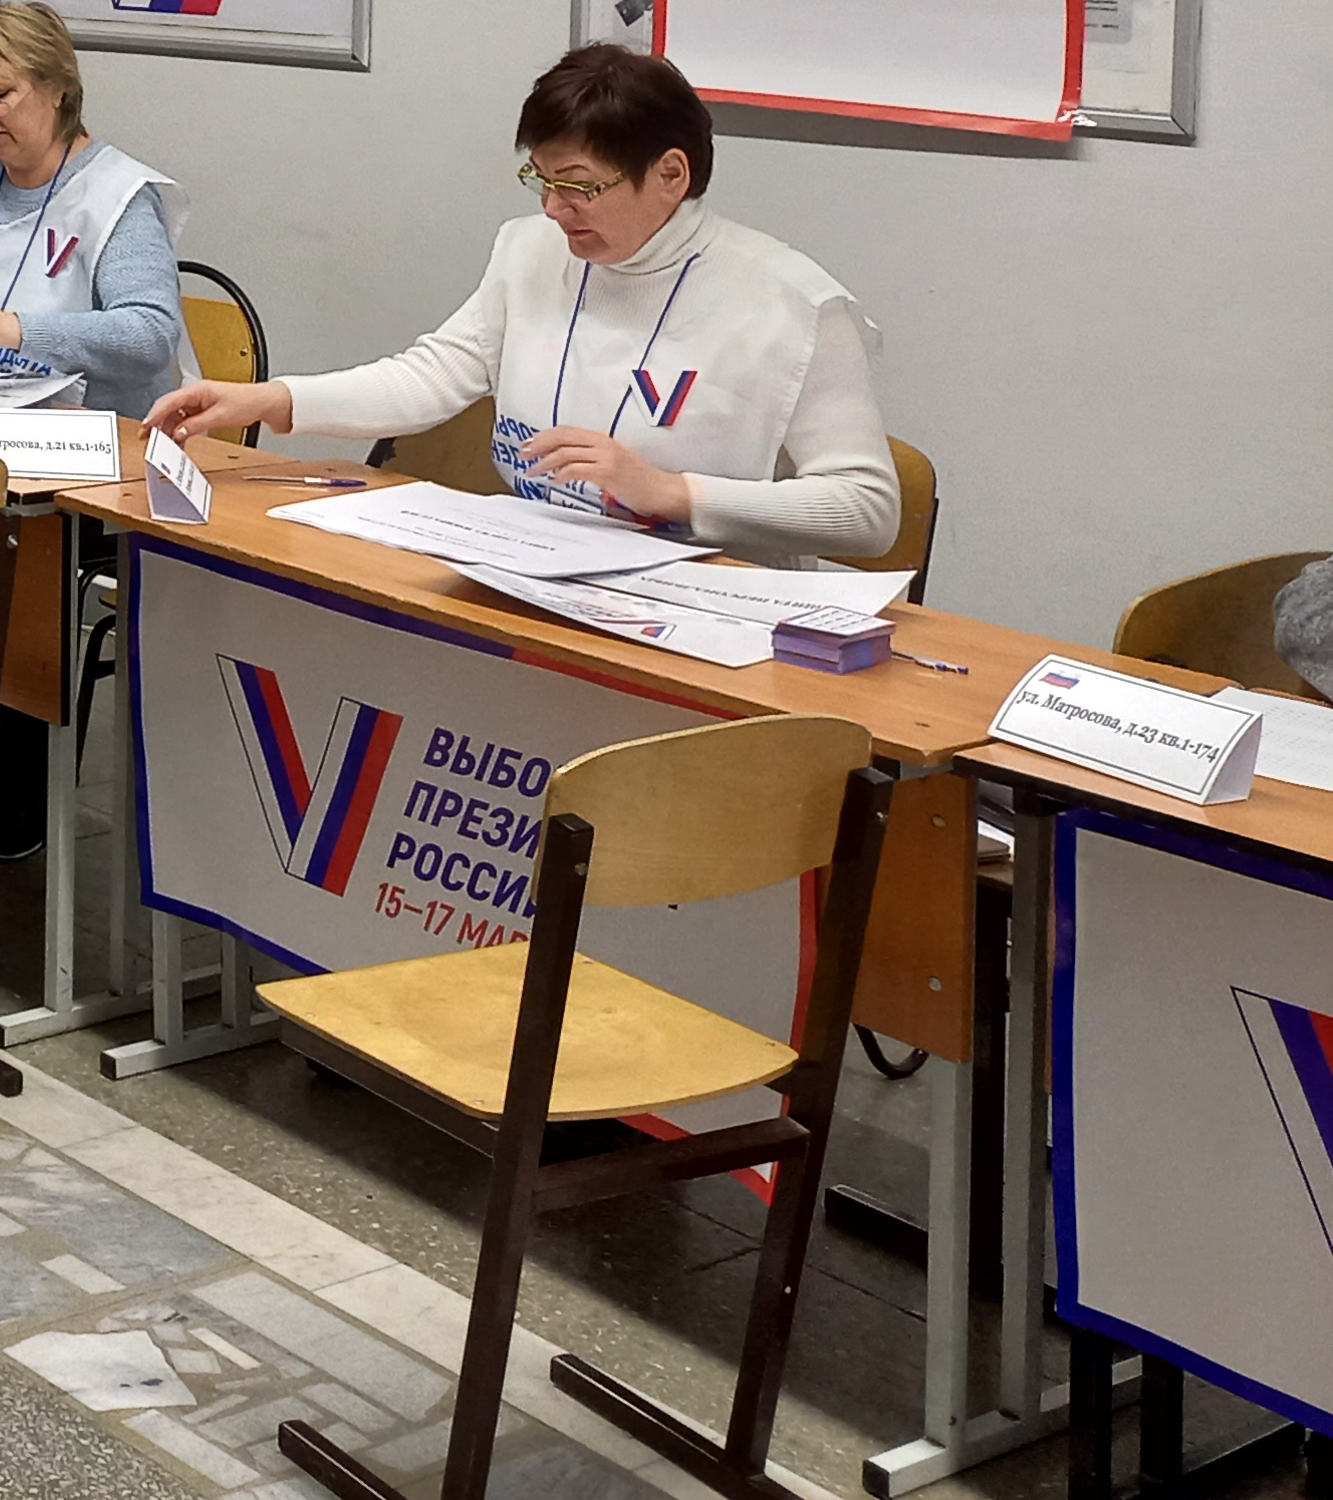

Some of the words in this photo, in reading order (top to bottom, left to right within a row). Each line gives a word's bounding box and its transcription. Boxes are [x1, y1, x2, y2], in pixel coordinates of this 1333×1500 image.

[45, 441, 67, 451] д.21
[423, 726, 552, 798] ВЫБО
[1015, 689, 1041, 705] ул.
[1041, 694, 1123, 734] Матросова,
[1122, 722, 1159, 744] д.23
[1157, 732, 1221, 764] кв.1-174
[402, 779, 542, 860] ПРЕЗИ
